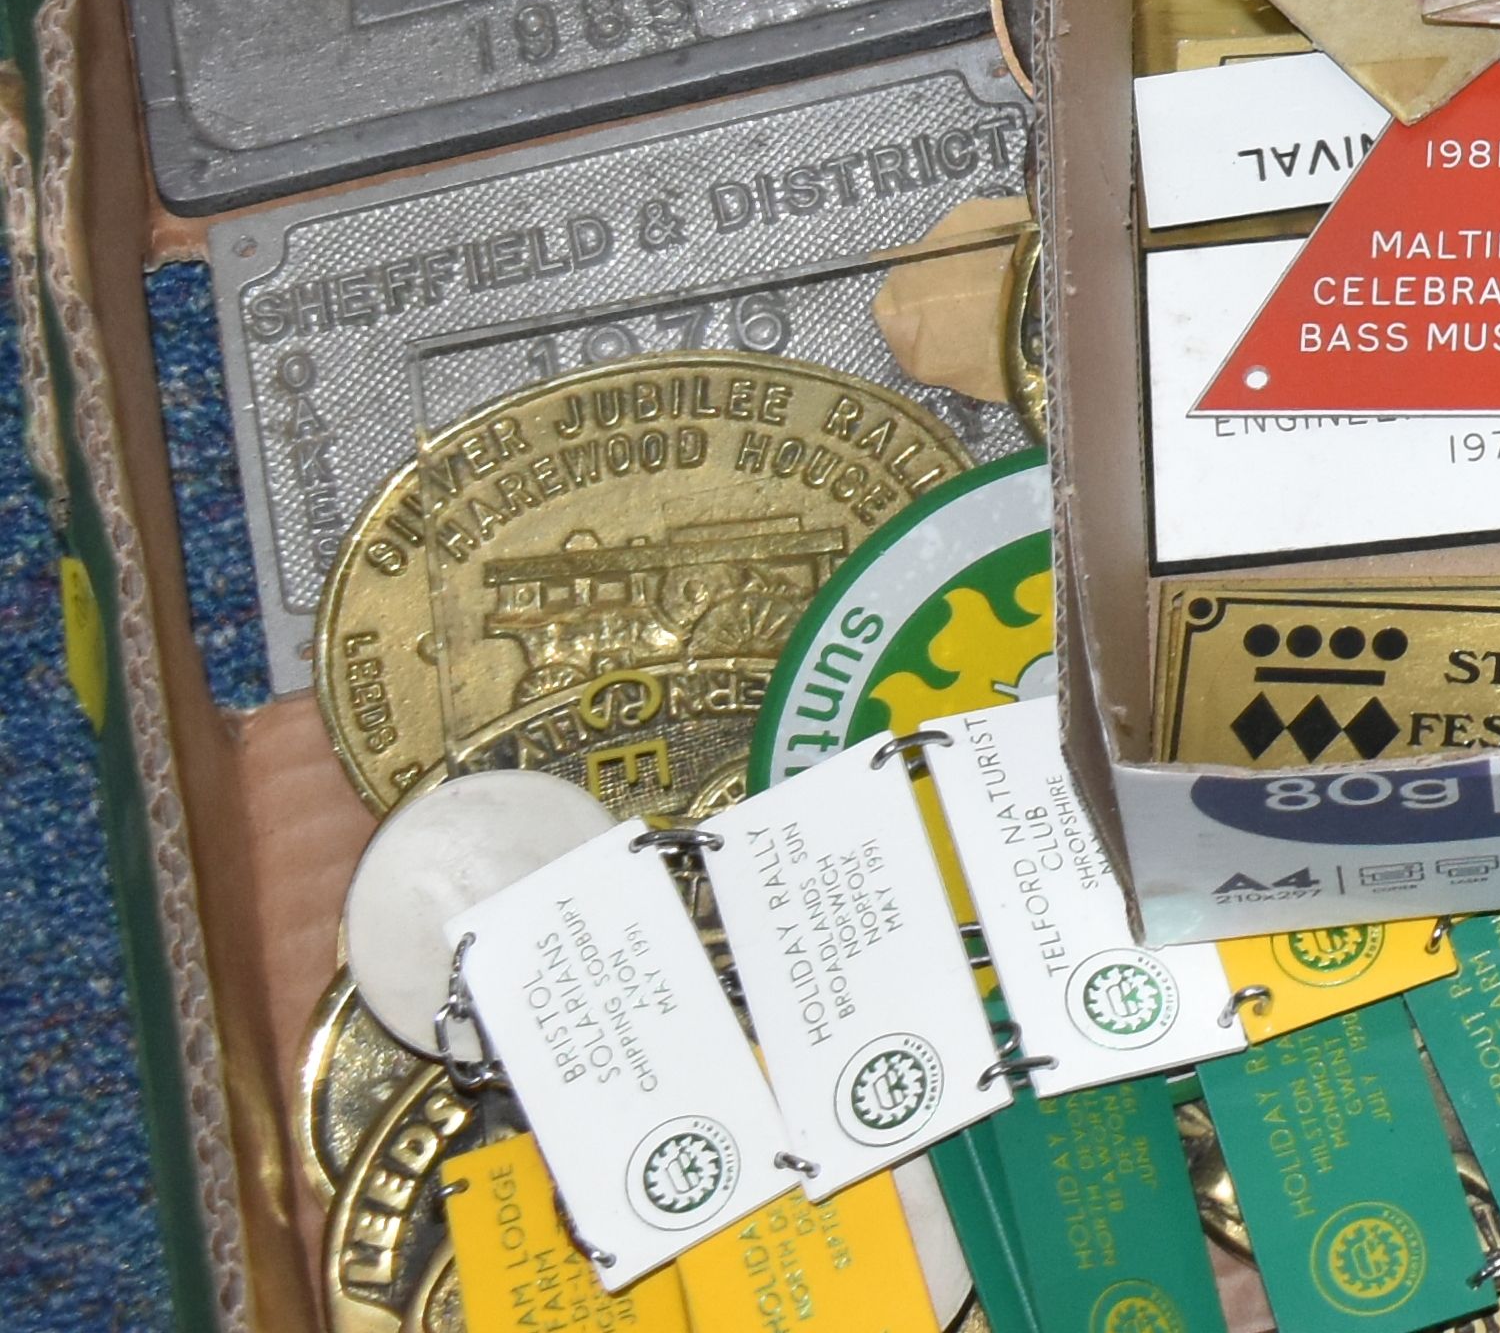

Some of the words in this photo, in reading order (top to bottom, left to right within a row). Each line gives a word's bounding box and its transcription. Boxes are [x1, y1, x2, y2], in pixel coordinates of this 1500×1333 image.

[250, 218, 612, 339] SHEFFIELD
[640, 201, 685, 250] &
[711, 118, 1017, 228] DISTRICT
[1301, 322, 1408, 352] BASS
[365, 417, 531, 579] SILVER
[560, 380, 794, 435] JUBILEE
[442, 431, 709, 564] HAREWOOD
[736, 433, 897, 525] HOUSE
[347, 631, 397, 752] LEEDS
[964, 718, 1025, 846] NATURIST
[1263, 771, 1460, 813] 80g
[748, 828, 791, 910] RALLY
[783, 821, 809, 864] SUN
[863, 839, 888, 876] 1991
[1024, 805, 1064, 872] CLUB
[1046, 774, 1100, 890] SHROPSHIRE
[818, 854, 863, 960] NORWICH
[840, 854, 884, 947] NORFOLK
[874, 885, 904, 930] MAY
[1013, 858, 1071, 978] TELFORD
[1211, 866, 1322, 896] A4
[1216, 889, 1323, 905] 210x297
[556, 896, 610, 984] SODBURY
[610, 949, 650, 1010] AVON
[624, 921, 651, 957] 1991
[776, 922, 833, 1046] HOLIDAY
[802, 877, 856, 1019] BROADLANDS
[522, 966, 587, 1085] BRISTOL
[536, 931, 623, 1085] SOLARIANS
[637, 969, 679, 1014] MAY
[600, 993, 659, 1094] CHIPPING
[1254, 1086, 1316, 1218] HOLIDAY
